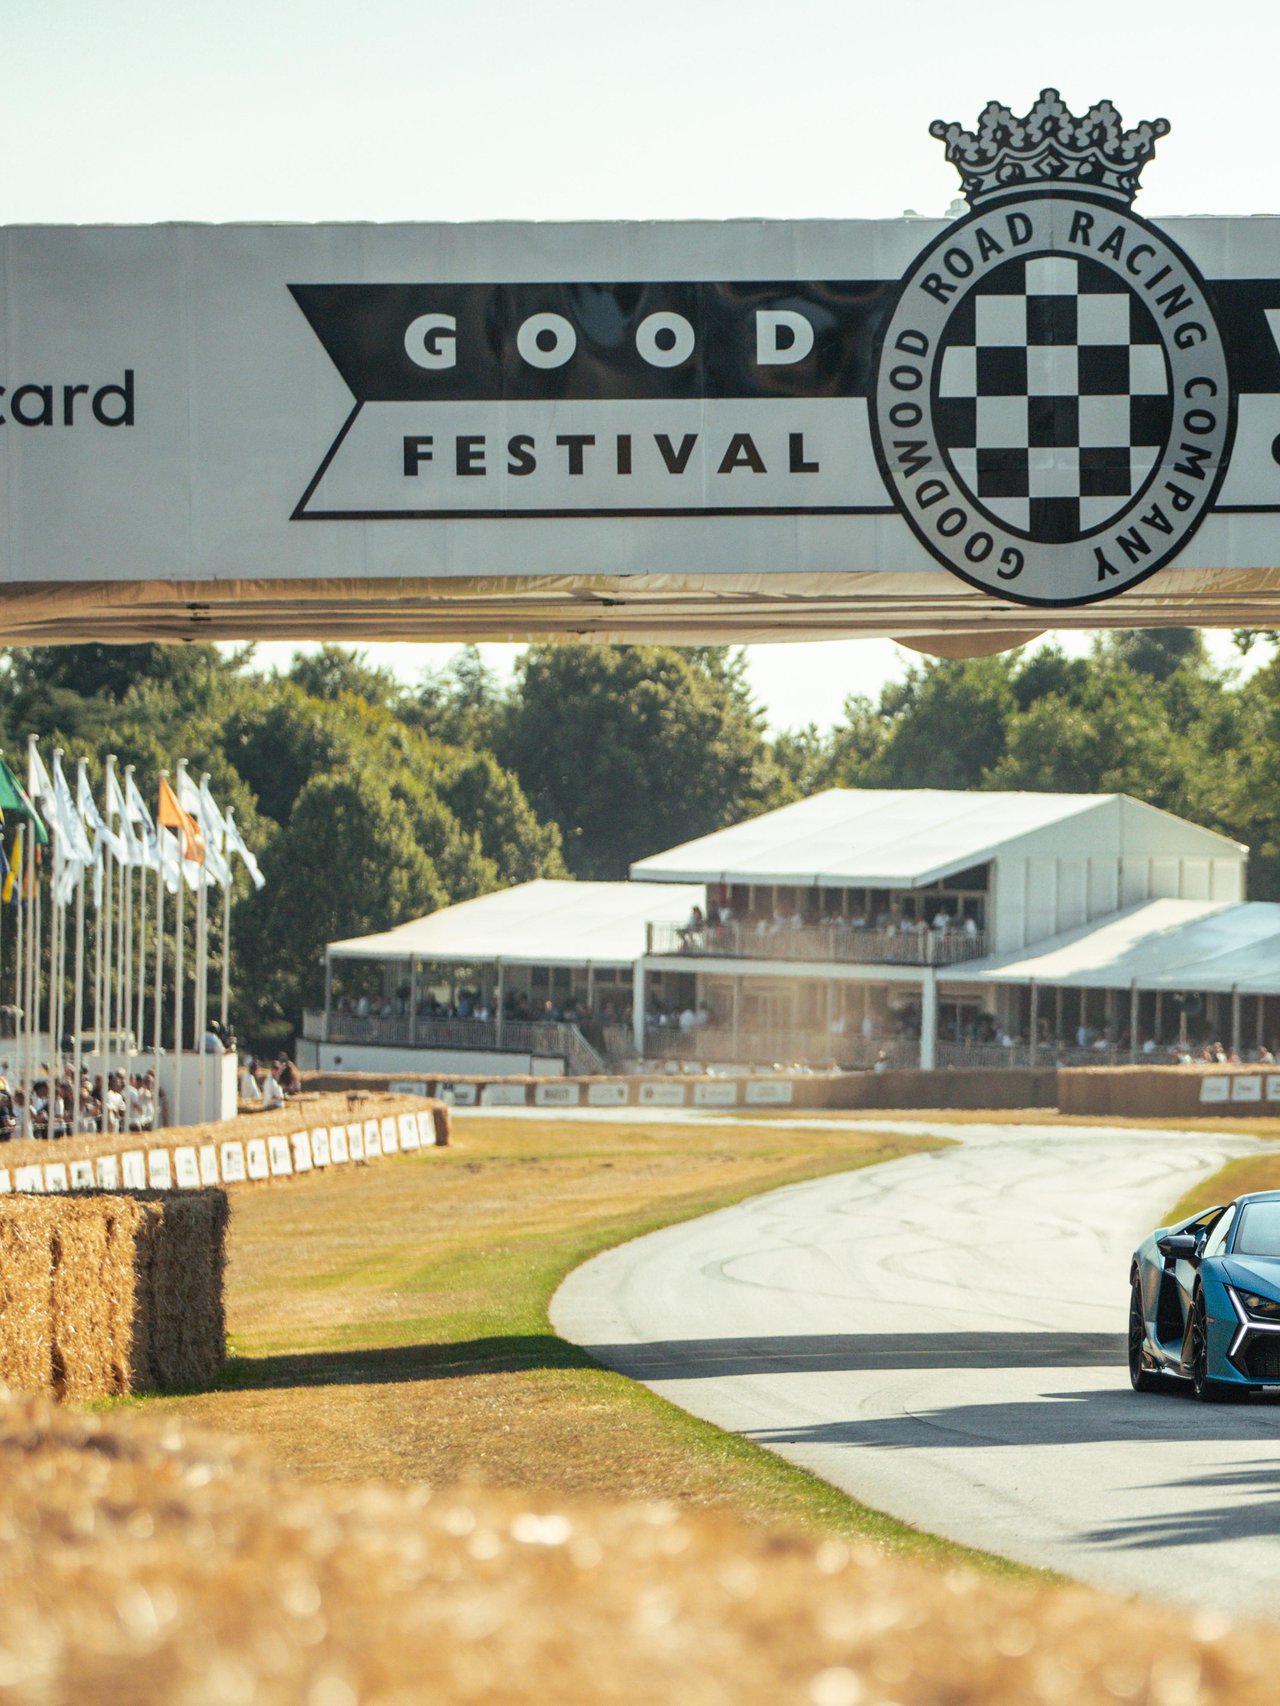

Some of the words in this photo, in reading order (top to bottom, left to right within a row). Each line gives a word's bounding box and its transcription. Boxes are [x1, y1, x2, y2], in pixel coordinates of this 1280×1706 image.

[919, 212, 1034, 305] ROAD
[1068, 209, 1208, 350] RACING
[404, 310, 815, 370] GOOD
[0, 369, 134, 427] ard
[403, 433, 820, 476] FESTIVAL
[889, 328, 1025, 580] GOODWOOD
[1093, 376, 1218, 582] COMPANY
